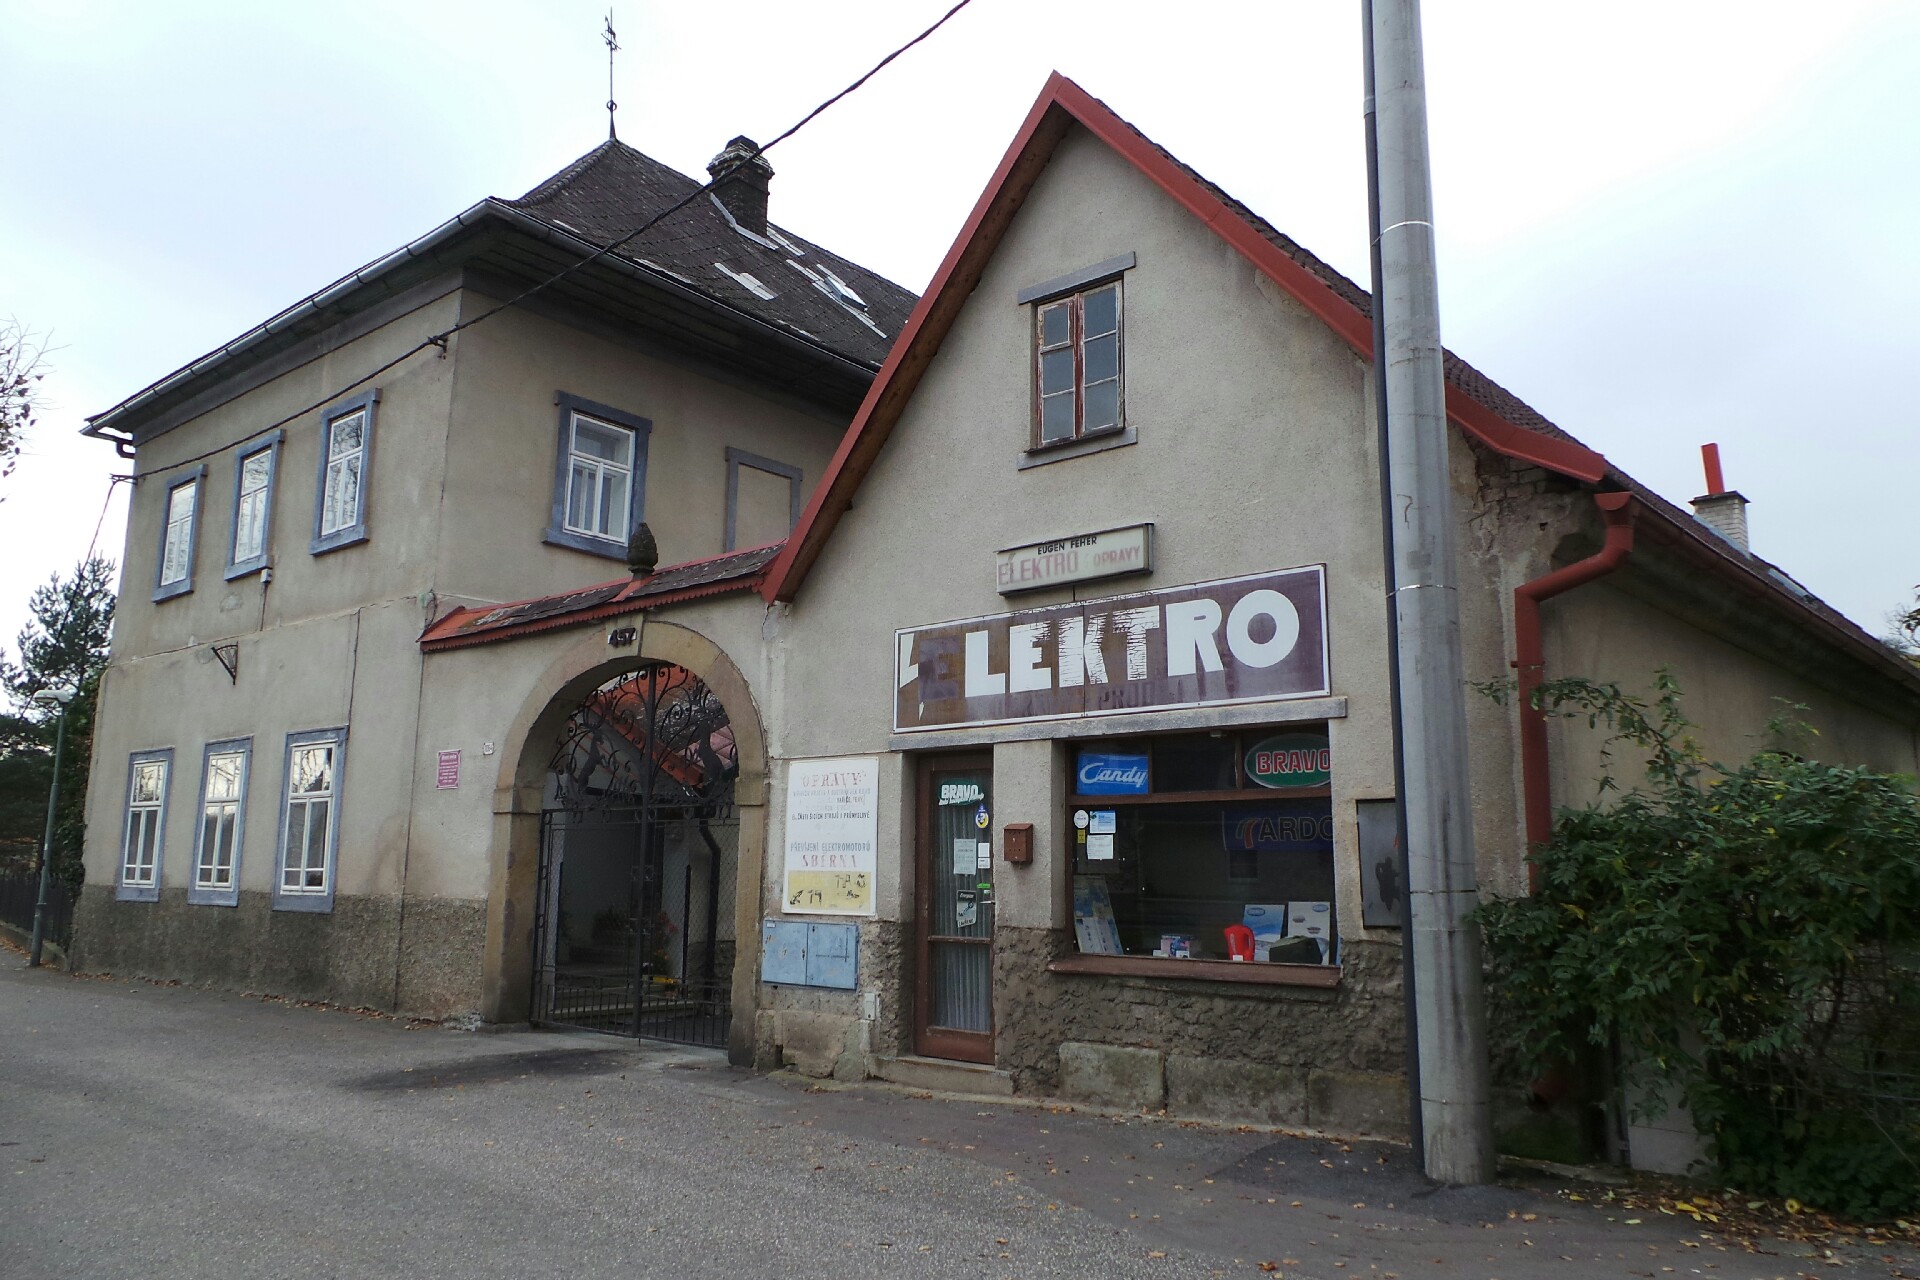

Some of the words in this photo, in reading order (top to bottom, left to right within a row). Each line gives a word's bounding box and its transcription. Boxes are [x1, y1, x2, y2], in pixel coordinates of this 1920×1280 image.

[1037, 542, 1065, 555] EUGEN
[1070, 536, 1097, 549] FEHER
[998, 551, 1079, 585] ELEKTRO
[1093, 546, 1141, 567] OPRAVY
[917, 589, 1300, 700] ELEKTRO
[1256, 748, 1331, 774] BRAVO
[1080, 763, 1147, 788] Candy
[941, 784, 979, 799] BRAVO
[790, 841, 819, 852] PŘEVÍJENÍ
[821, 840, 871, 852] ELEKTROMOTORŮ
